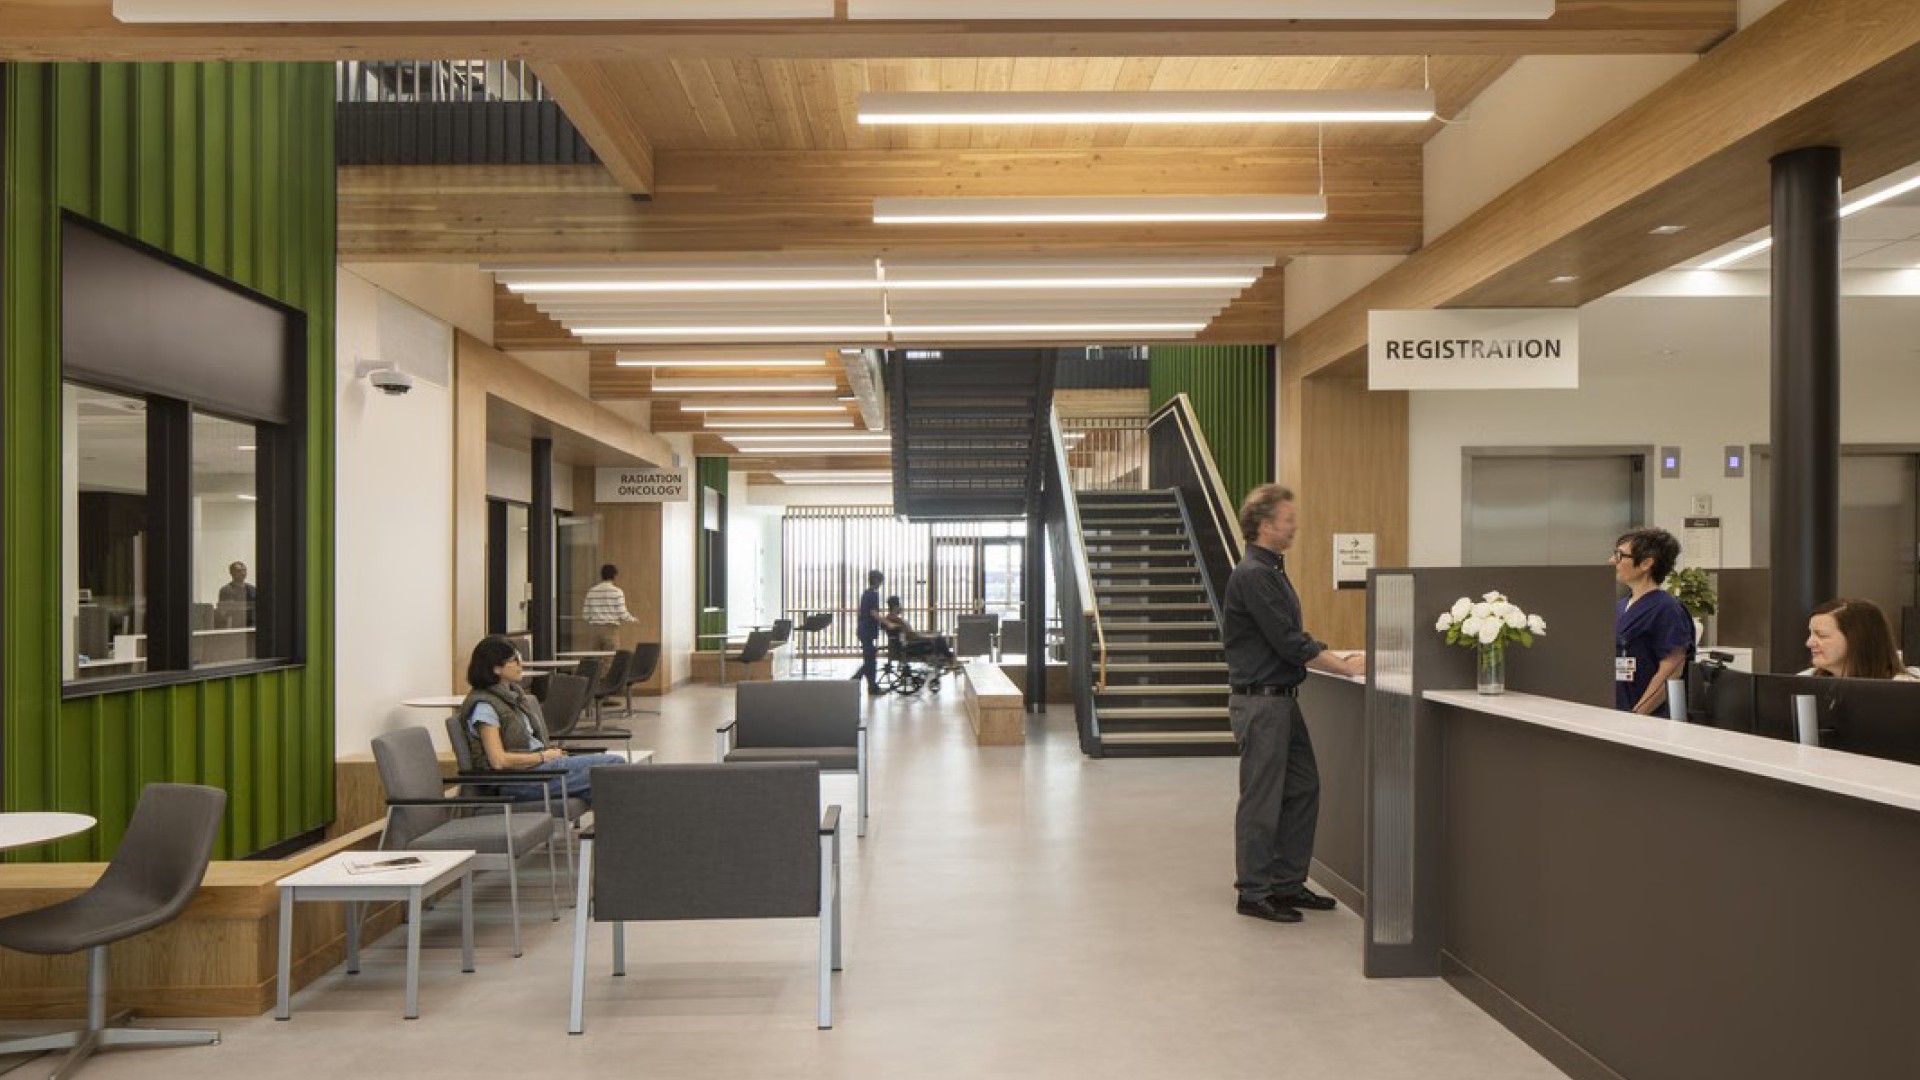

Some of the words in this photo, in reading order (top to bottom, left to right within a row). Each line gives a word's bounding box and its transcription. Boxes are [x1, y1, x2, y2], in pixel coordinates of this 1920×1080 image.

[1386, 339, 1561, 360] REGISTRATION
[620, 474, 682, 483] RADIATION
[618, 485, 682, 495] ONCOLOGY
